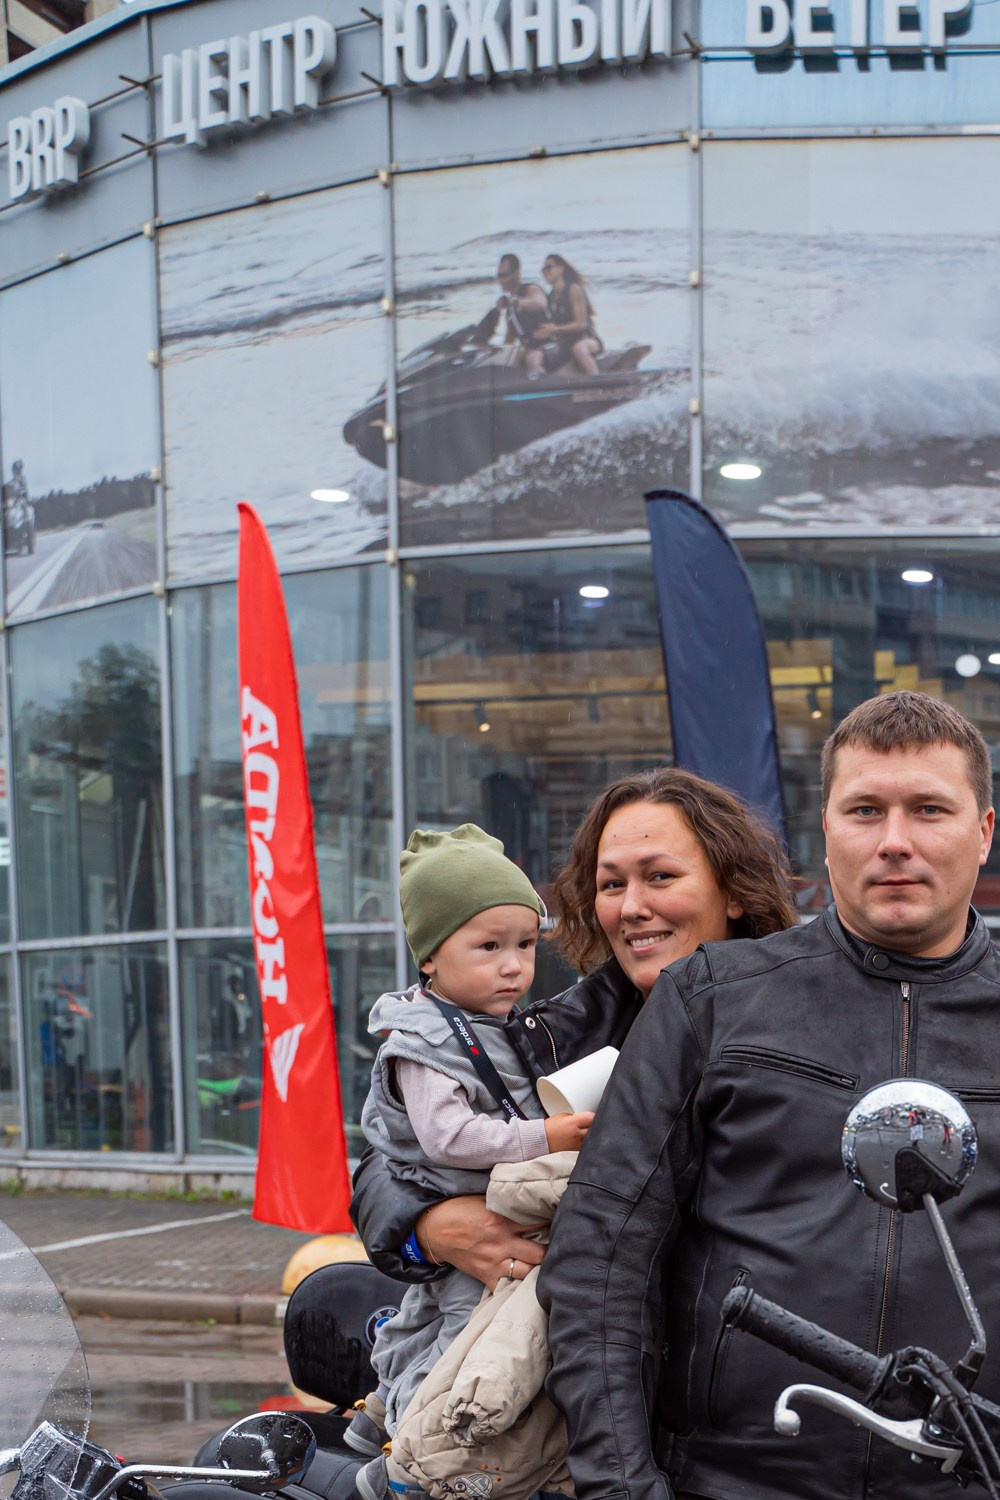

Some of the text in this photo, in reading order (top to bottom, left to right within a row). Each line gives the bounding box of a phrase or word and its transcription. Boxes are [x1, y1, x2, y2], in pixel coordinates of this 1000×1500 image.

[162, 15, 335, 144] ЦЕНТР
[8, 97, 88, 200] BRP
[501, 1098, 520, 1118] deca
